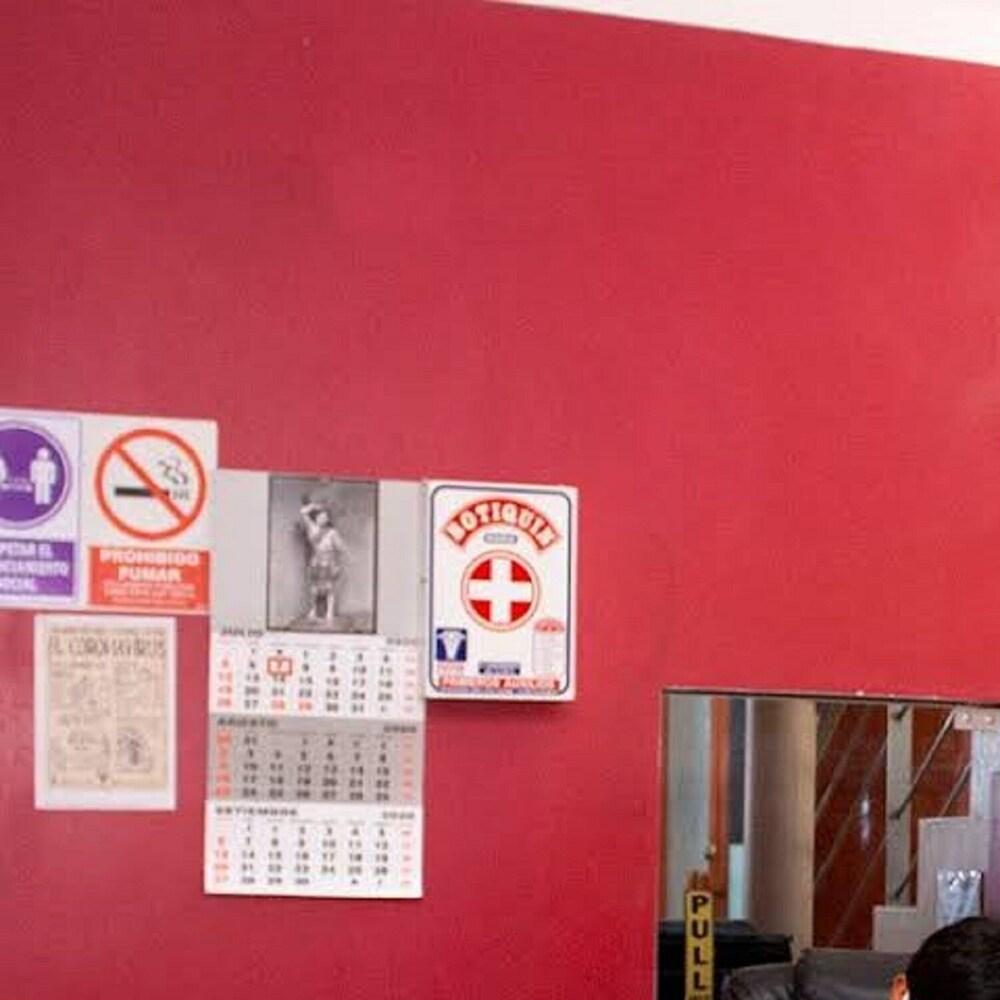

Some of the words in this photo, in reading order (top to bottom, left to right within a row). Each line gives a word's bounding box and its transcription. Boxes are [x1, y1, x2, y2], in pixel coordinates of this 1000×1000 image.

[100, 549, 200, 566] PROHIBIDO
[118, 566, 182, 583] FUMAR
[692, 895, 709, 990] PULL
